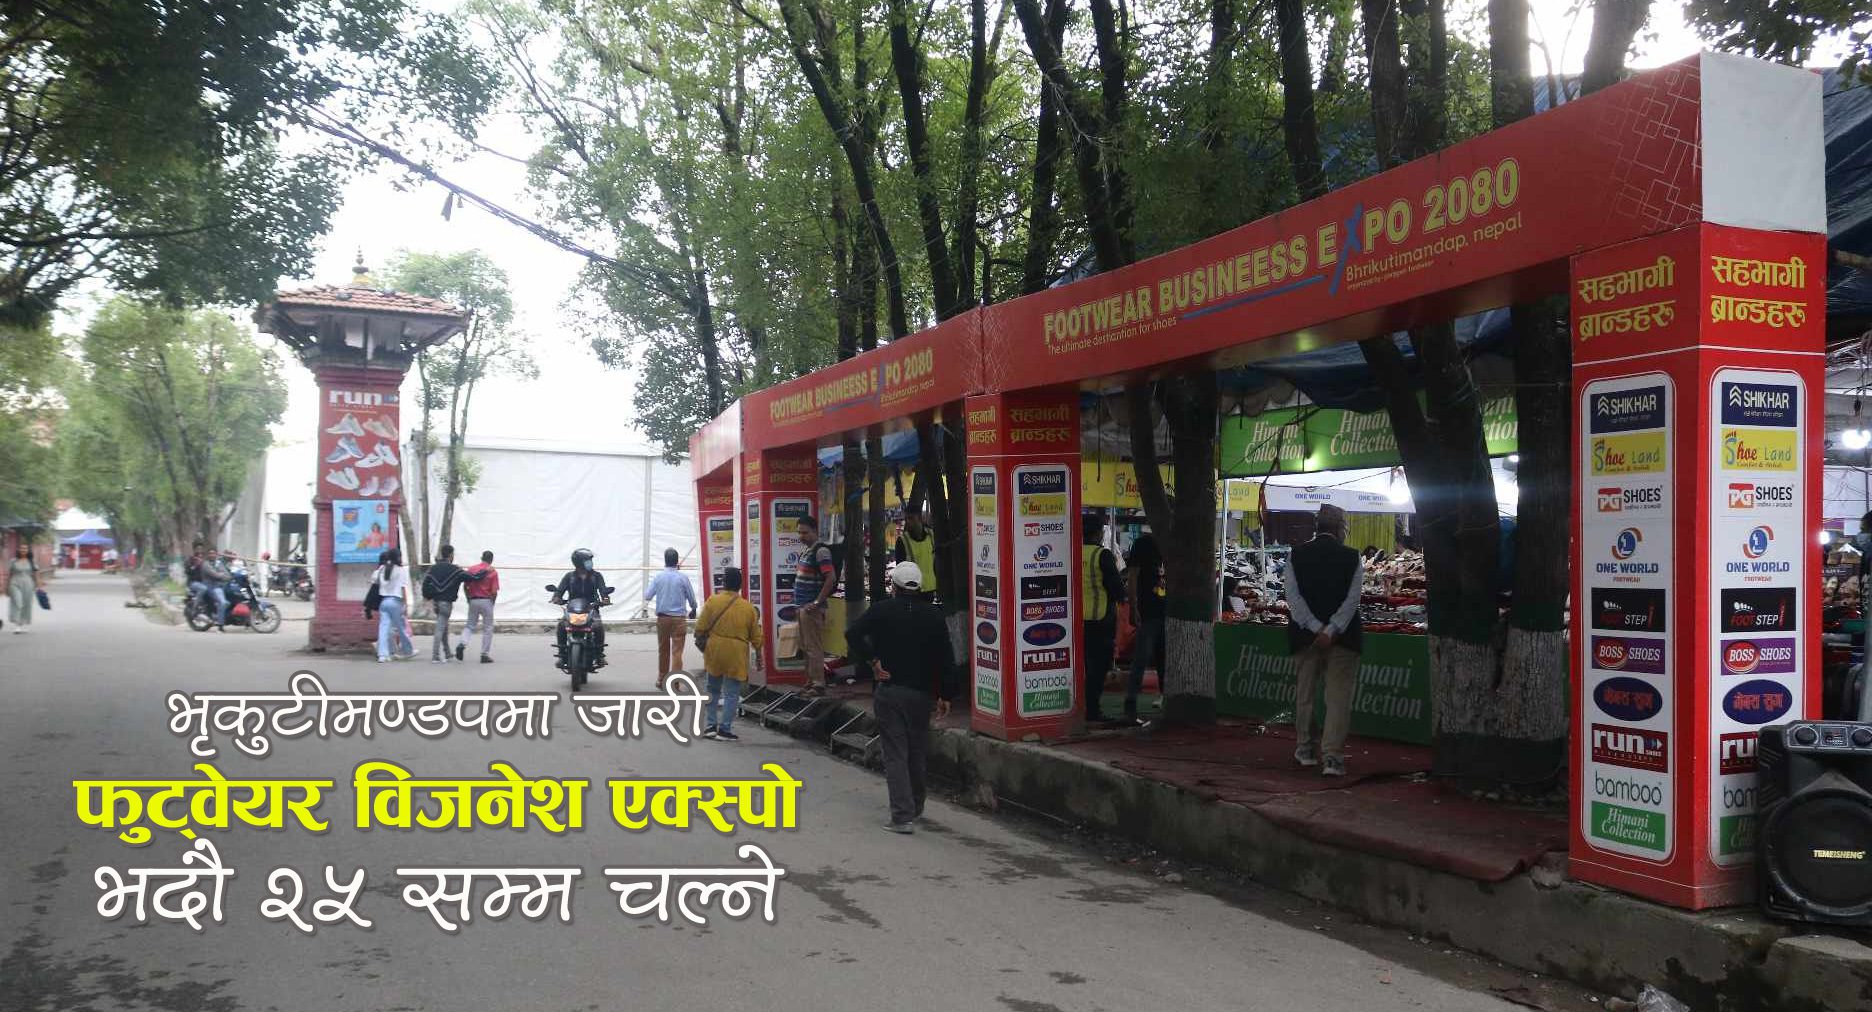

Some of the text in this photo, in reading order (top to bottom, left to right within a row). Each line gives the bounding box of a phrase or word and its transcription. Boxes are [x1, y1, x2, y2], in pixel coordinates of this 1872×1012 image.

[1473, 211, 1523, 241] nepal
[1043, 286, 1154, 346] FOOTWEAR
[1157, 234, 1309, 315] BUSINEESS
[1423, 157, 1521, 234] 2080
[1577, 255, 1676, 304] सहभागी
[1711, 254, 1807, 290] सहभागी
[1152, 316, 1178, 331] shoes
[769, 390, 815, 424] FOOTWEAR
[904, 349, 934, 383] 2080
[329, 390, 383, 407] run
[1610, 394, 1658, 416] SHIKHAR
[1743, 390, 1790, 410] SHIKHAR
[1340, 408, 1392, 433] Himan
[1631, 446, 1661, 464] Land
[1764, 446, 1792, 461] Land
[1032, 474, 1062, 485] SHIKHAR
[1623, 487, 1662, 504] SHOES
[1756, 486, 1793, 501] SHOES
[1041, 523, 1064, 532] SHOES
[1596, 563, 1659, 574] ONE WORLD
[1726, 561, 1790, 573] ONE WORLD
[1045, 603, 1066, 614] SHOES
[1624, 614, 1648, 626] STEP
[1755, 614, 1779, 626] STEP
[1023, 651, 1056, 665] run
[1599, 644, 1661, 662] BOSS SHOES
[1729, 647, 1792, 663] BOSS SHOES
[1024, 674, 1068, 690] bamboo
[1357, 658, 1414, 689] mani
[1226, 669, 1298, 702] Collectio
[1350, 684, 1423, 720] llection
[1593, 729, 1645, 755] run
[1721, 737, 1758, 760] ru
[1595, 770, 1662, 806] bamboo
[1723, 784, 1760, 812] bam
[1607, 807, 1650, 828] Himani
[1601, 820, 1656, 844] Collection
